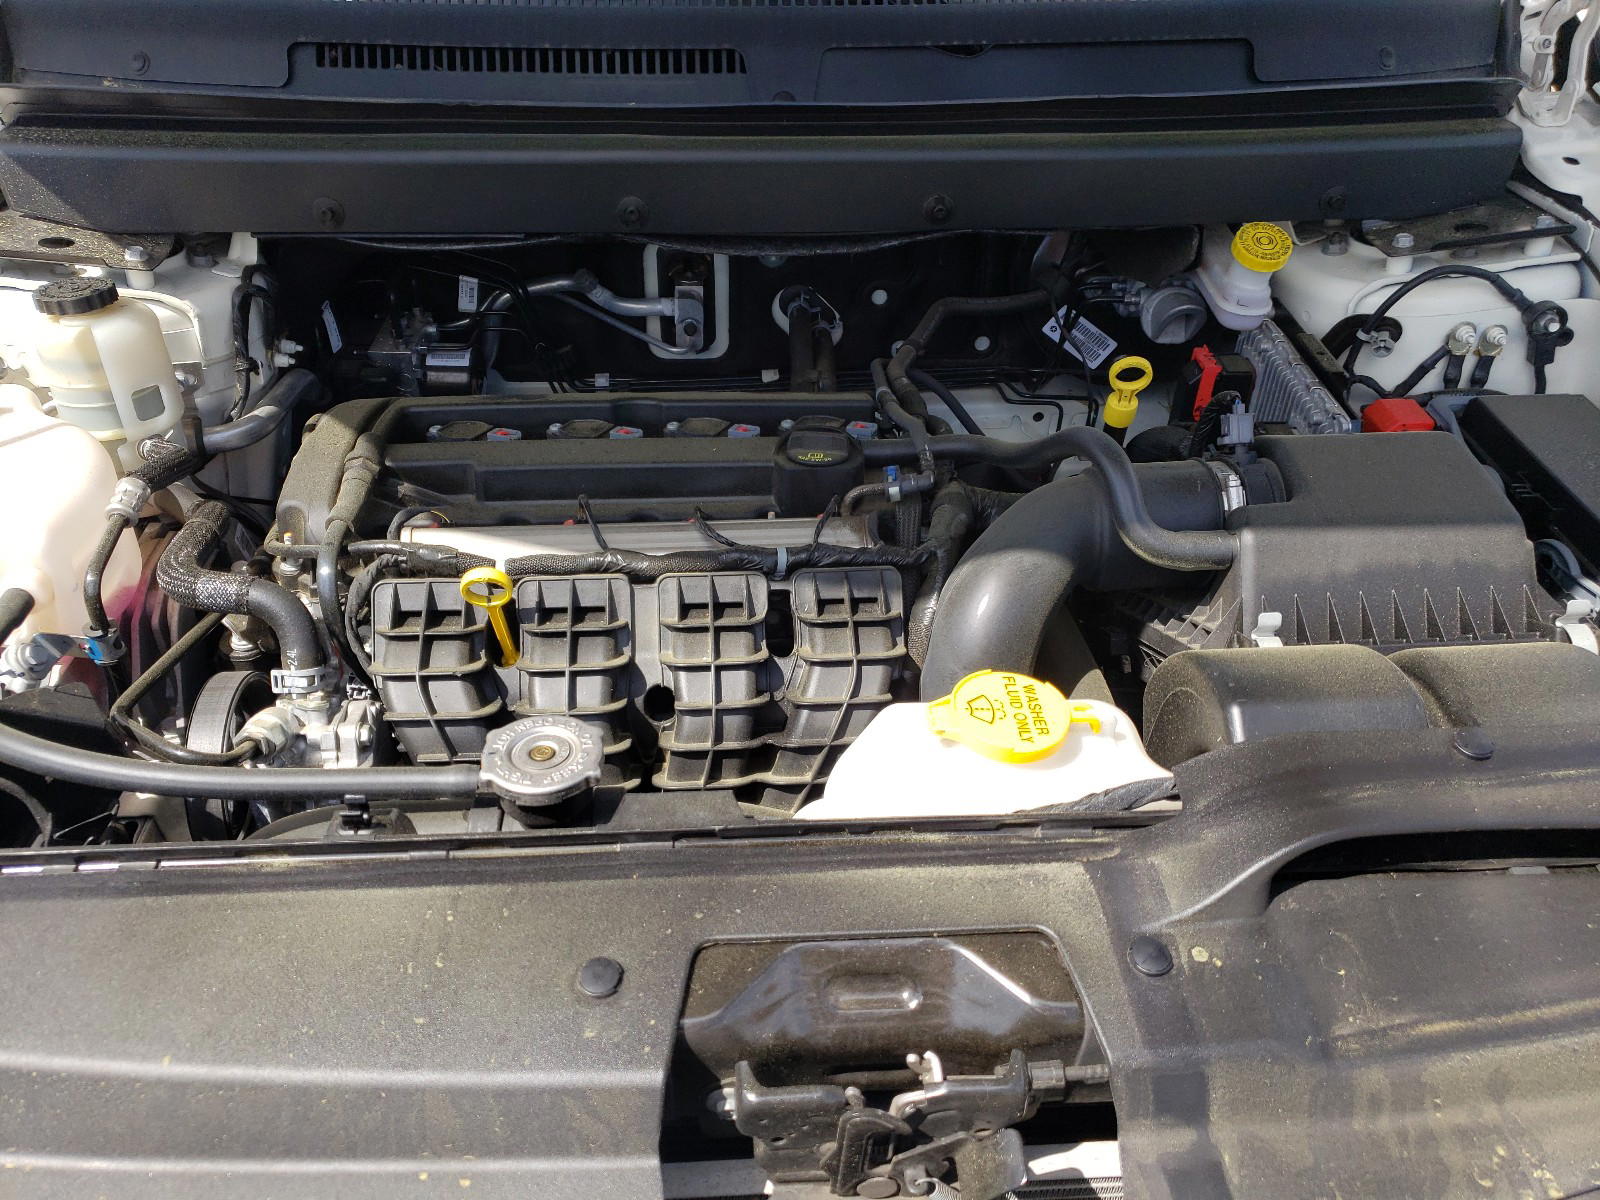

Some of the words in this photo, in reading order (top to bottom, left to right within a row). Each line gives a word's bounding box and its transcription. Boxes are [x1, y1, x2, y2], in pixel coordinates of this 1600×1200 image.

[286, 648, 298, 666] 2.4L
[1002, 676, 1023, 710] FLUID
[1013, 713, 1034, 743] ONLY
[1022, 684, 1050, 736] WASHER
[514, 717, 554, 732] OPEN
[492, 730, 516, 751] HOT
